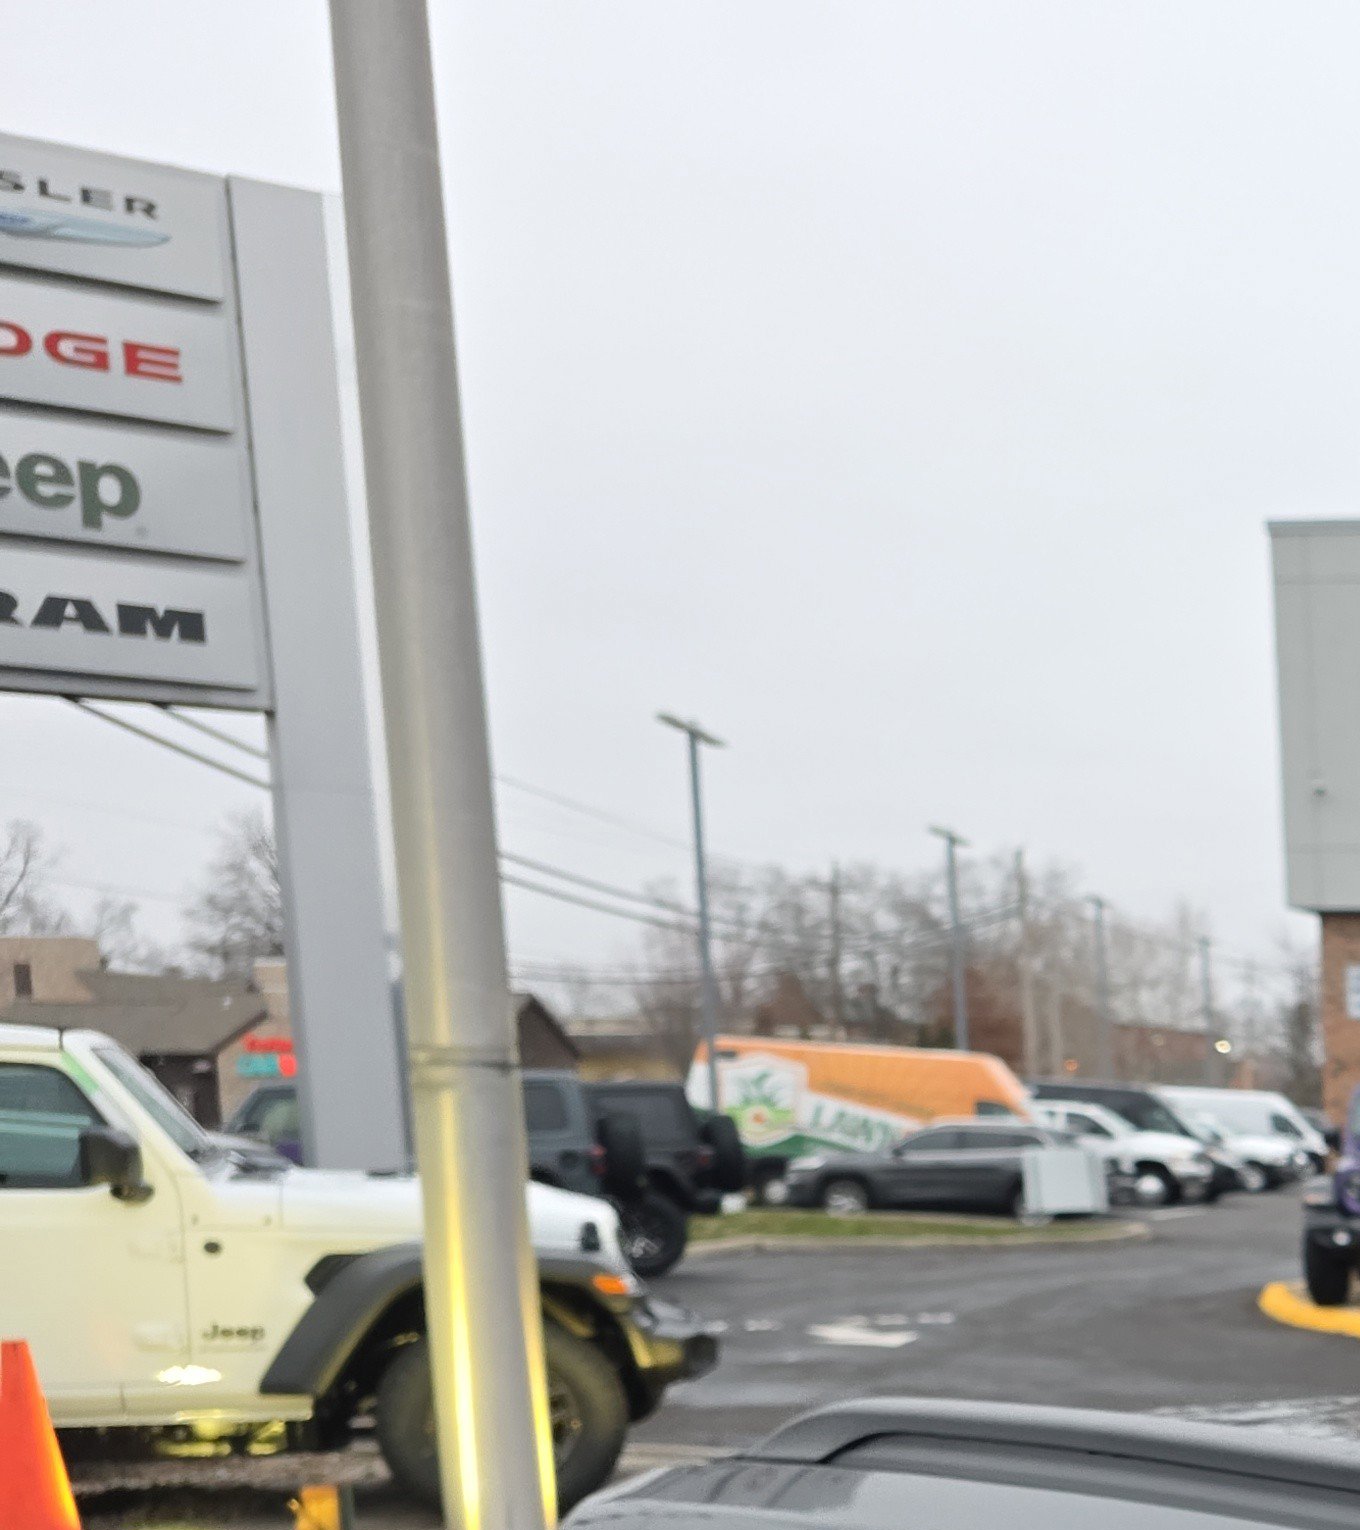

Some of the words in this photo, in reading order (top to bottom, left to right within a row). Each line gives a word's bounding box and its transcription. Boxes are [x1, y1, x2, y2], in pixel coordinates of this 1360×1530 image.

[0, 452, 141, 530] ep
[0, 590, 207, 645] AM
[202, 1323, 266, 1345] Jeep
